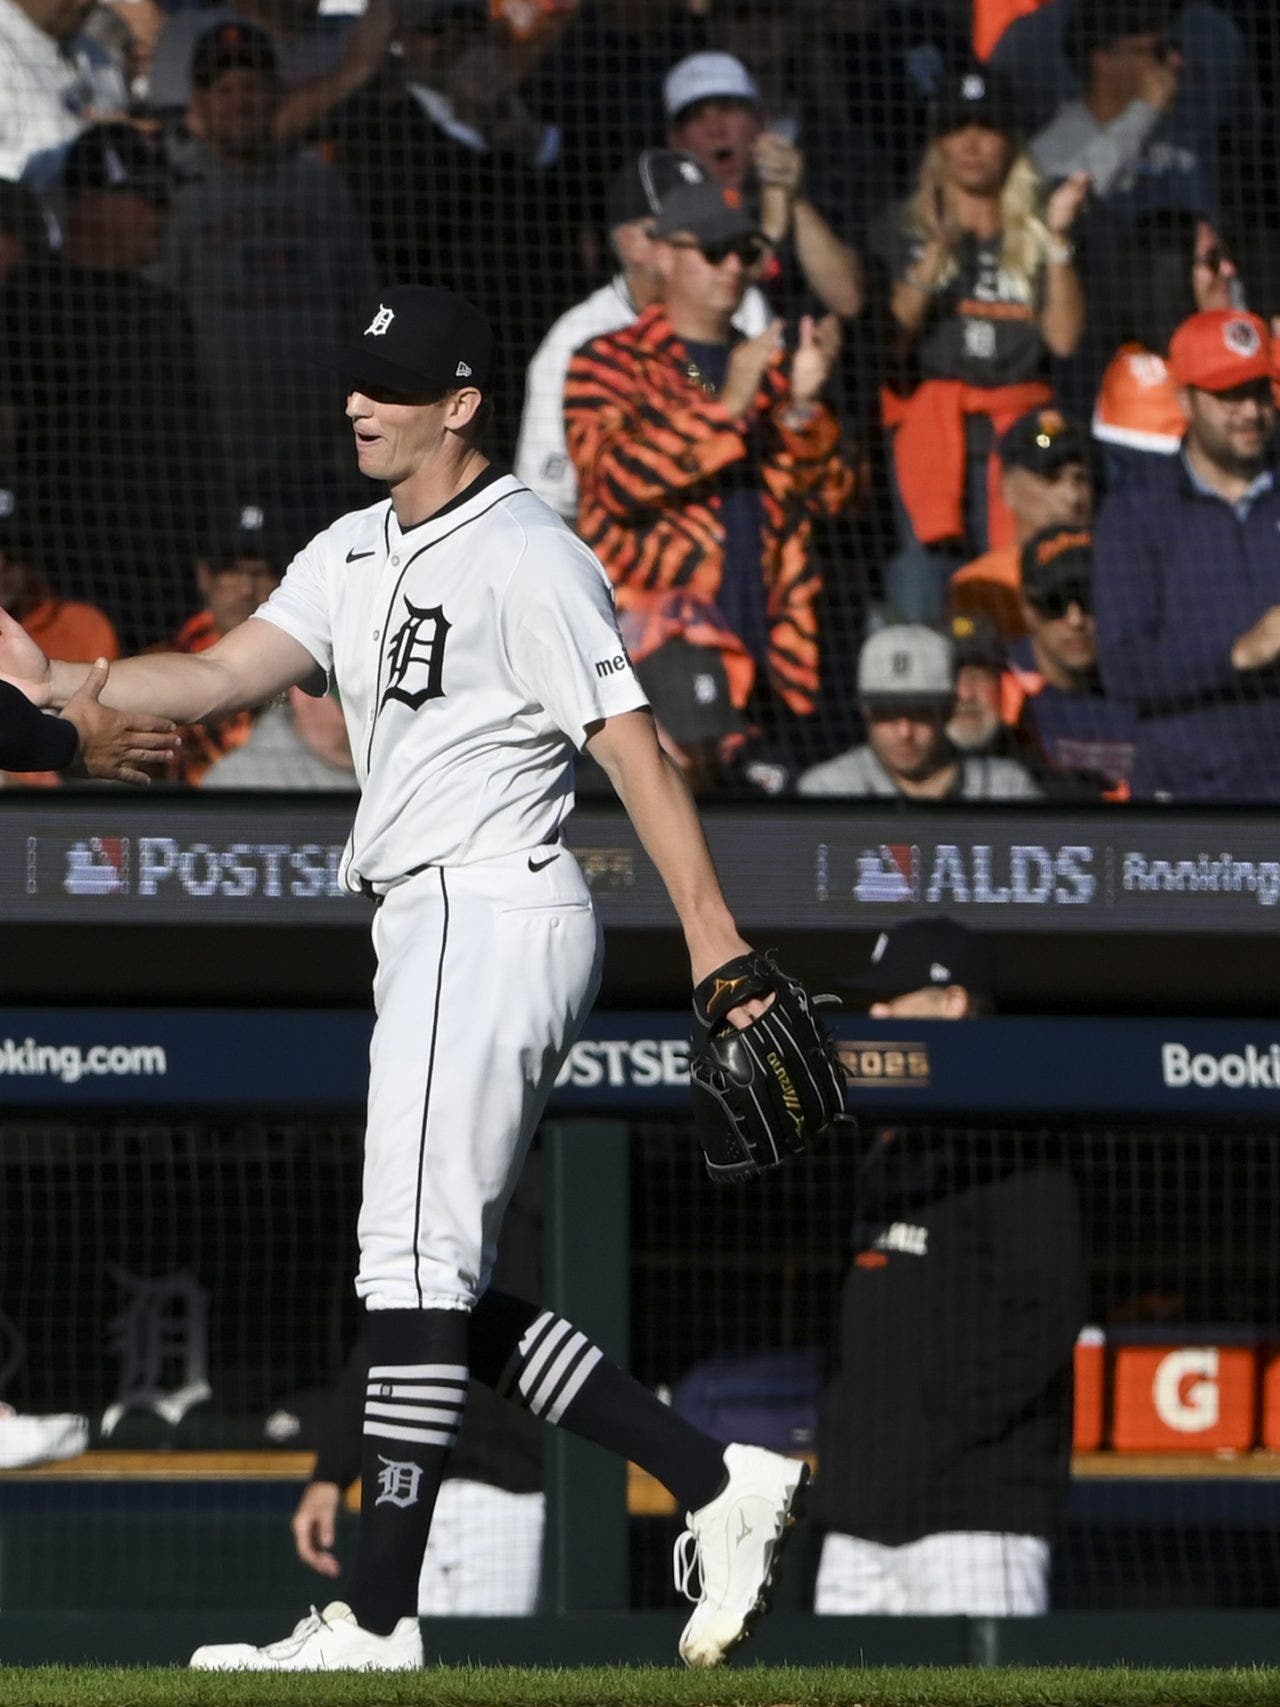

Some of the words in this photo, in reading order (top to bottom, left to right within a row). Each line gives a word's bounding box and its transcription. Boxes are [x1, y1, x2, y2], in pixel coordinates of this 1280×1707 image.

[363, 303, 395, 336] D
[378, 594, 453, 716] D
[926, 845, 1096, 903] ALDS
[1152, 1347, 1221, 1432] G
[375, 1453, 424, 1508] D
